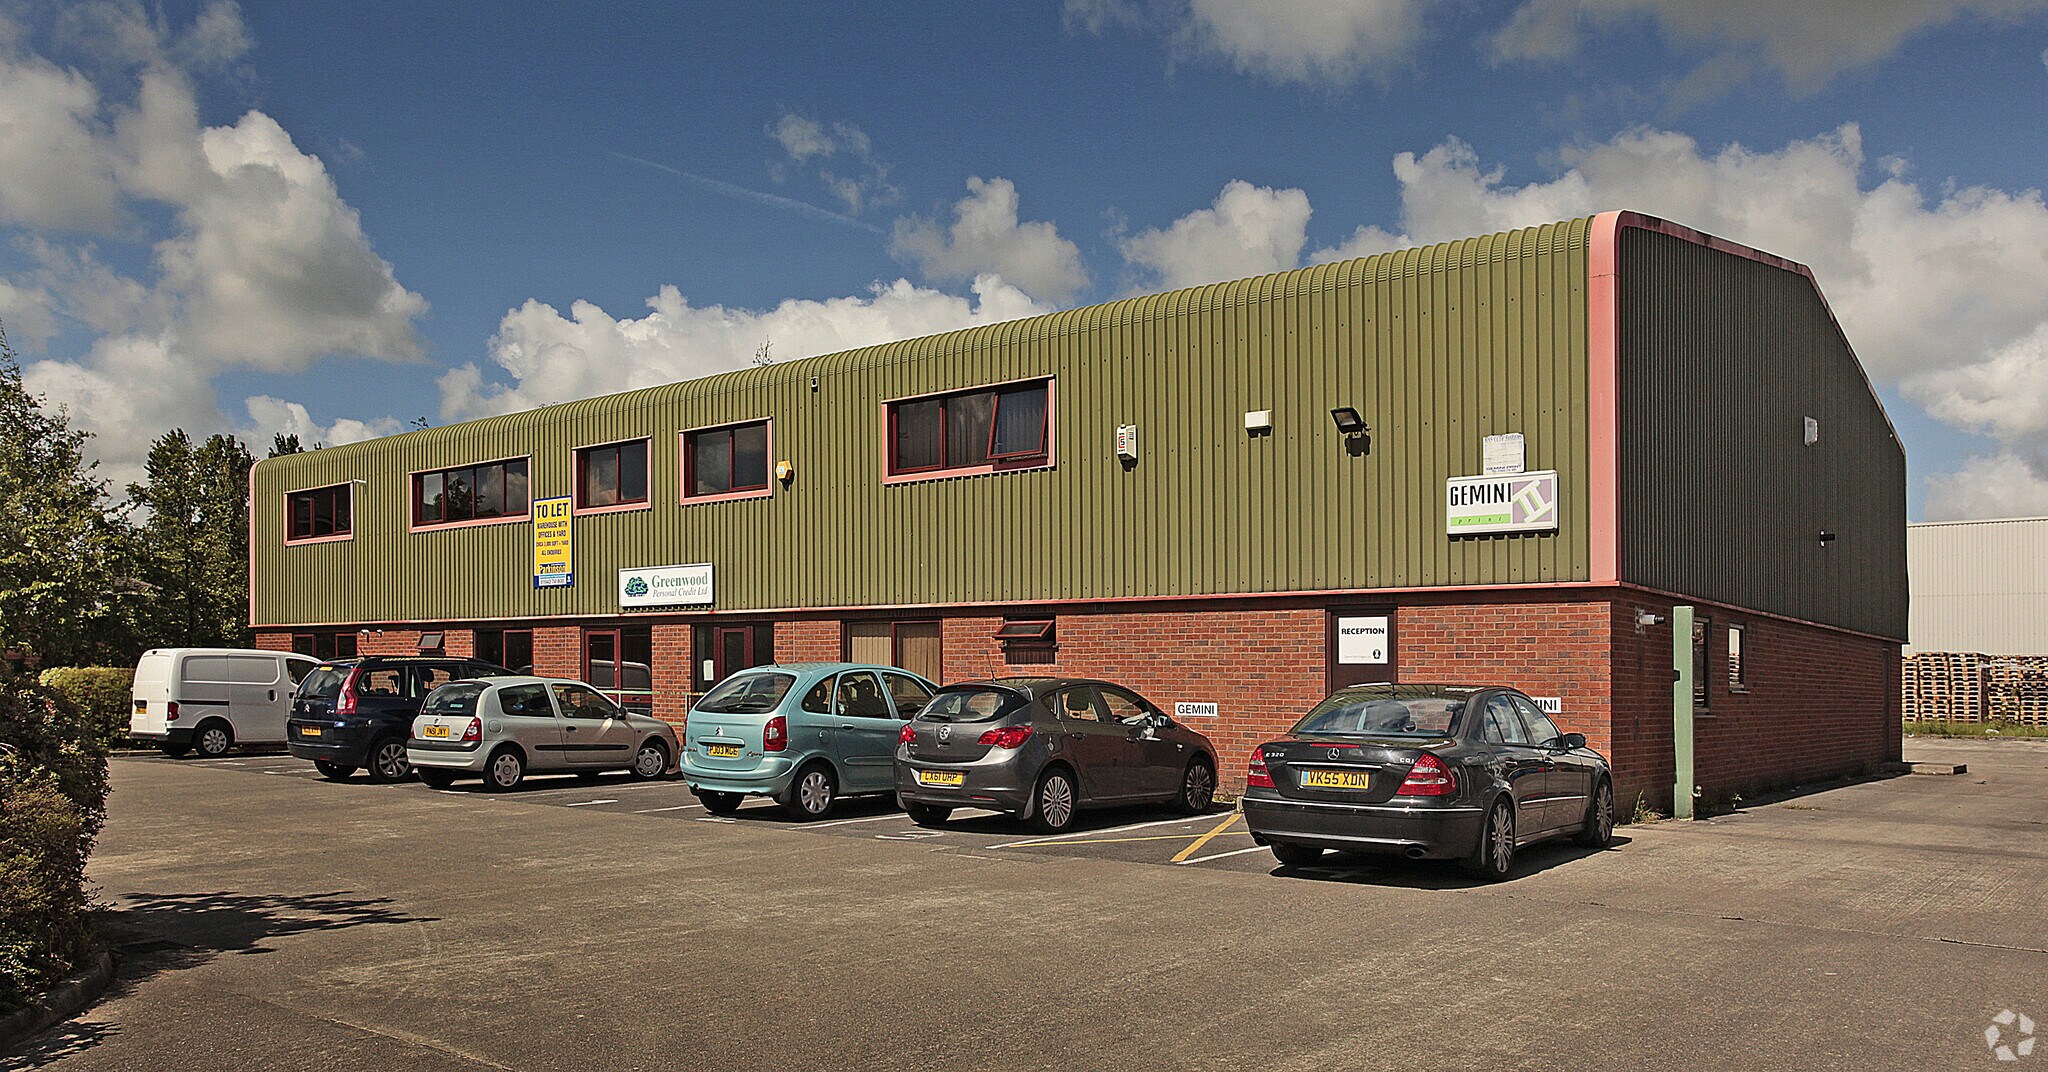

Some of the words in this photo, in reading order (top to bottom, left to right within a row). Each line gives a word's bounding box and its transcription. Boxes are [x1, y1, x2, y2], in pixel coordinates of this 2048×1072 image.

[1450, 482, 1512, 506] GEMINI
[536, 505, 548, 518] TO
[551, 502, 568, 517] LET
[652, 572, 708, 588] Greenwood
[652, 589, 677, 598] Personal
[678, 588, 696, 597] Credit
[697, 587, 708, 596] Ltd
[1341, 627, 1385, 635] RECEPTION
[1178, 704, 1215, 715] GEMINI
[1309, 772, 1340, 785] VK55
